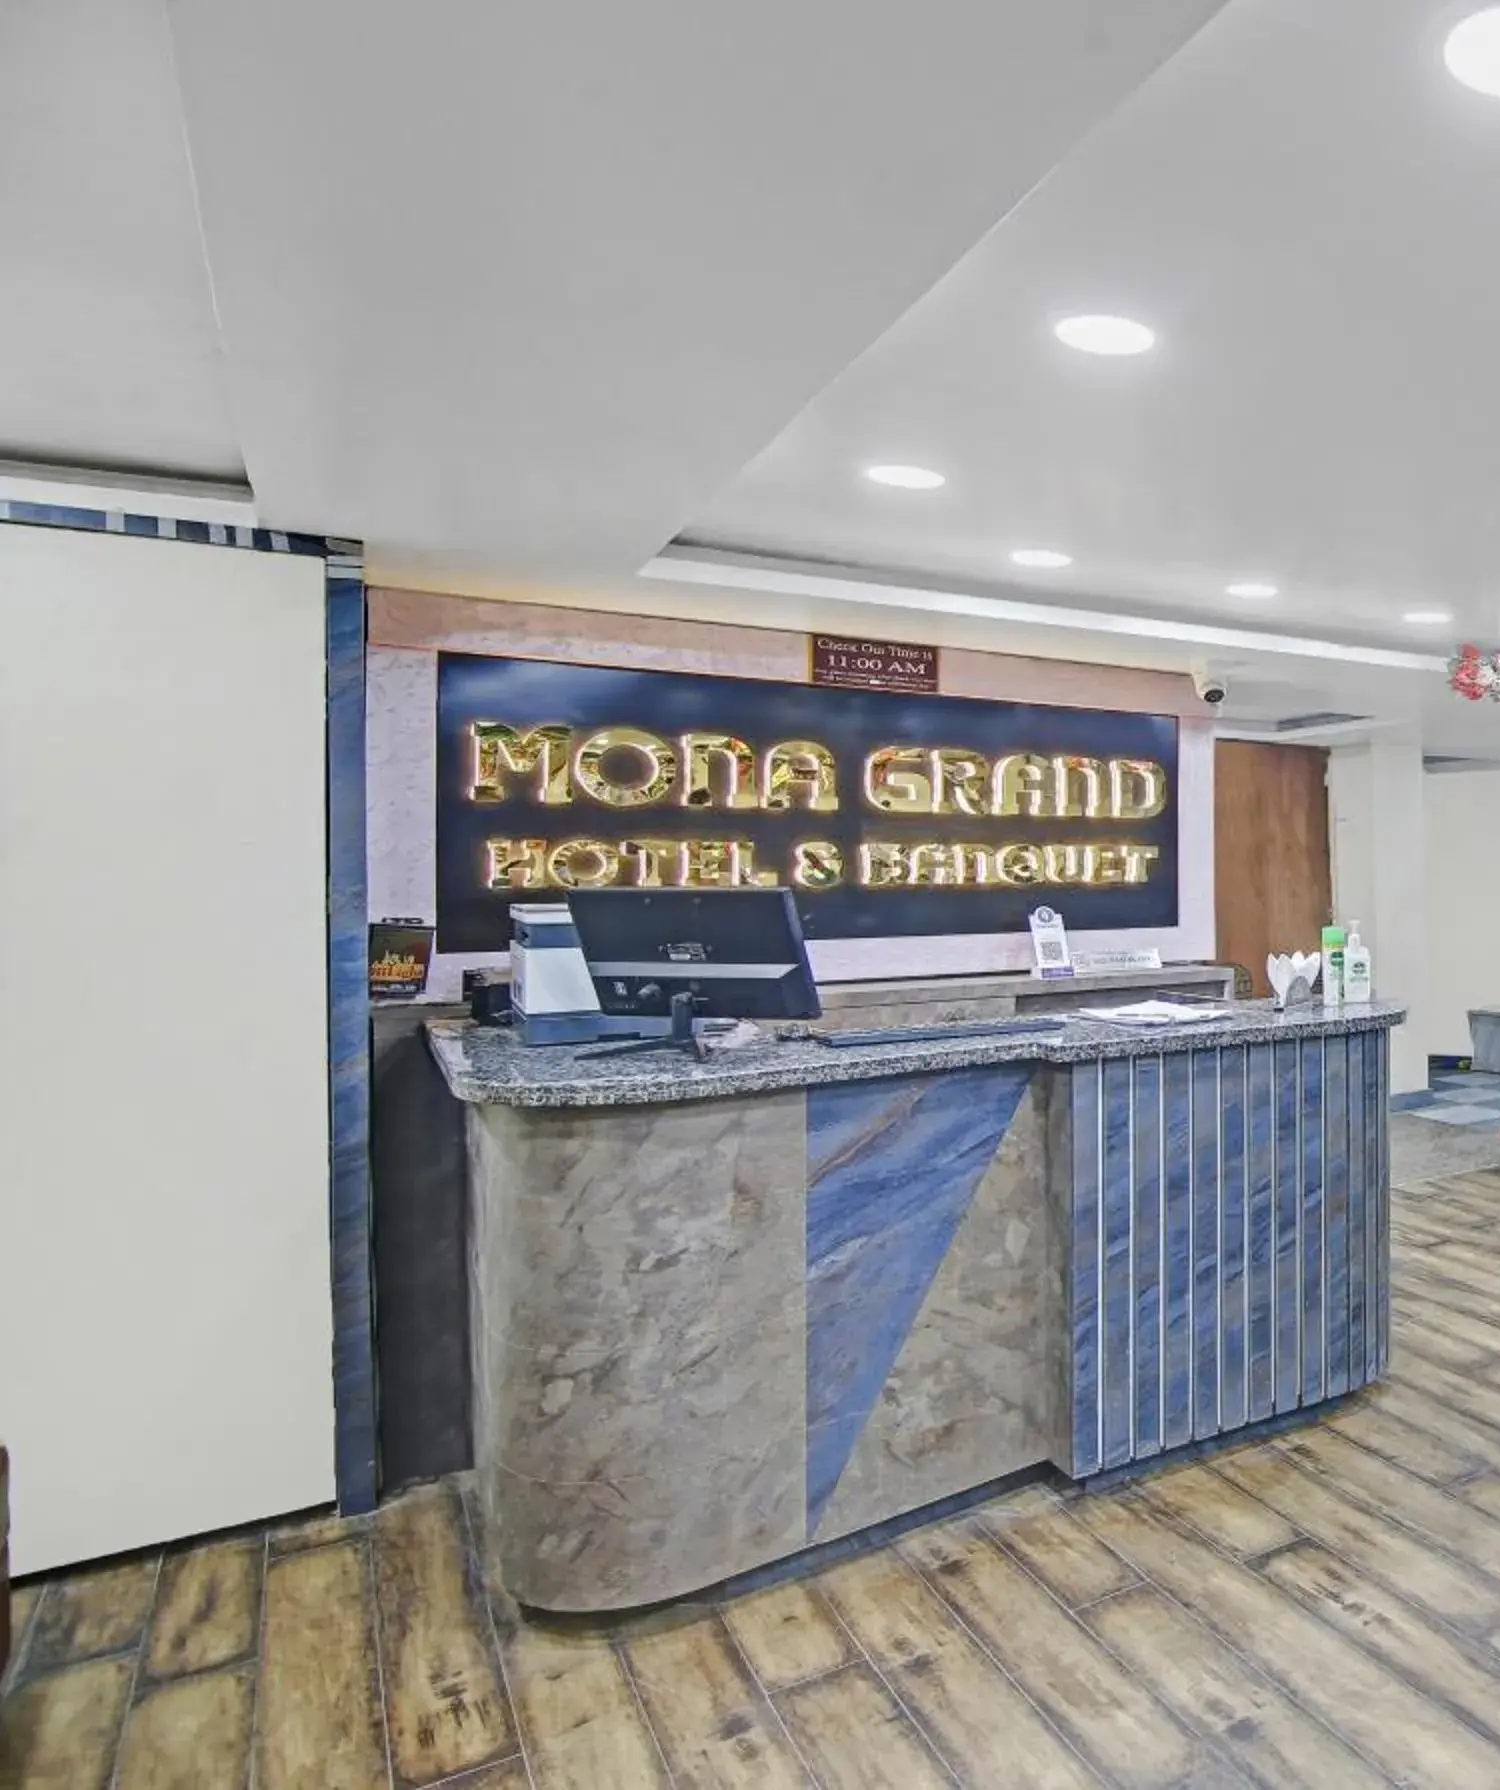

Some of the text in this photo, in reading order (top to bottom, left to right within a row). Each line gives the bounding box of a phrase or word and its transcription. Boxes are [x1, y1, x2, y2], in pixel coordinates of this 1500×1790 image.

[818, 640, 859, 653] Check
[861, 643, 885, 655] Out
[887, 645, 919, 658] Time
[828, 654, 882, 671] 11:00
[888, 660, 927, 675] AM
[470, 721, 1166, 818] MONA GRAND
[487, 838, 1159, 889] HOTEL & BANQUET
